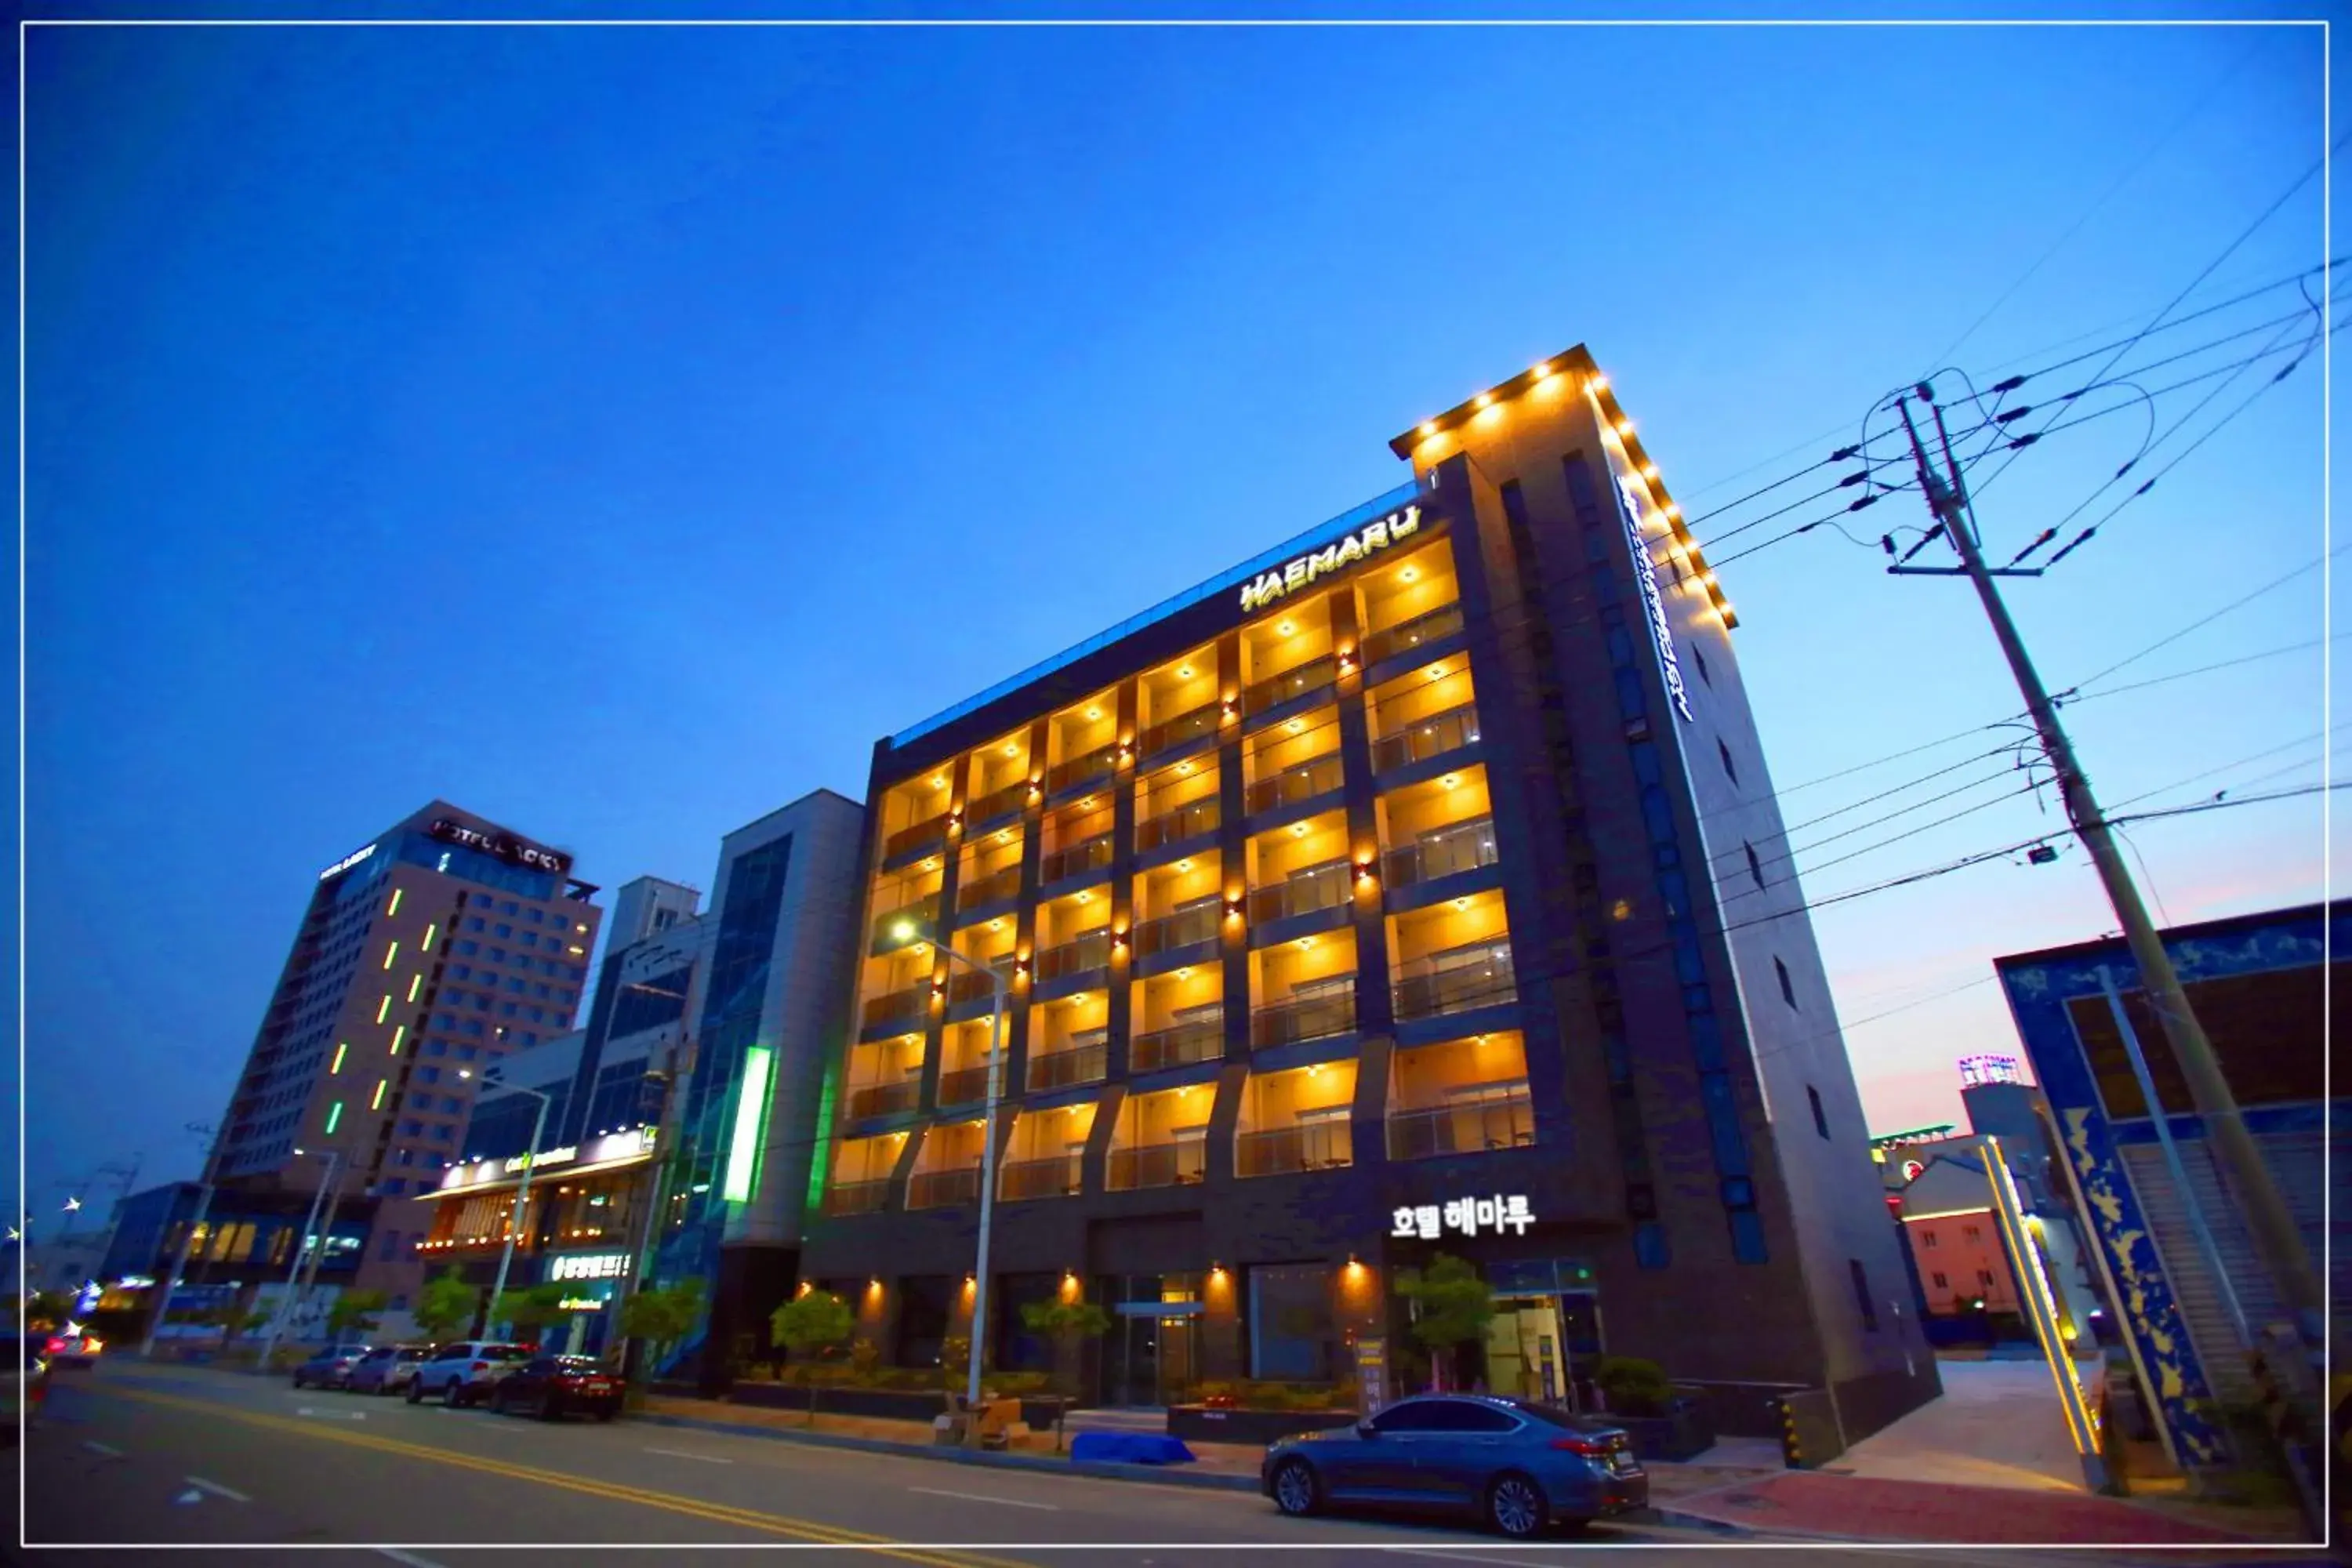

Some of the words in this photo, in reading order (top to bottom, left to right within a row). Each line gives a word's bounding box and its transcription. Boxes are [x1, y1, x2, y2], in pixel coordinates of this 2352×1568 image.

[1240, 505, 1421, 612] HAEMARU
[1391, 1205, 1441, 1240] 호텔
[1443, 1193, 1536, 1237] 해마루
